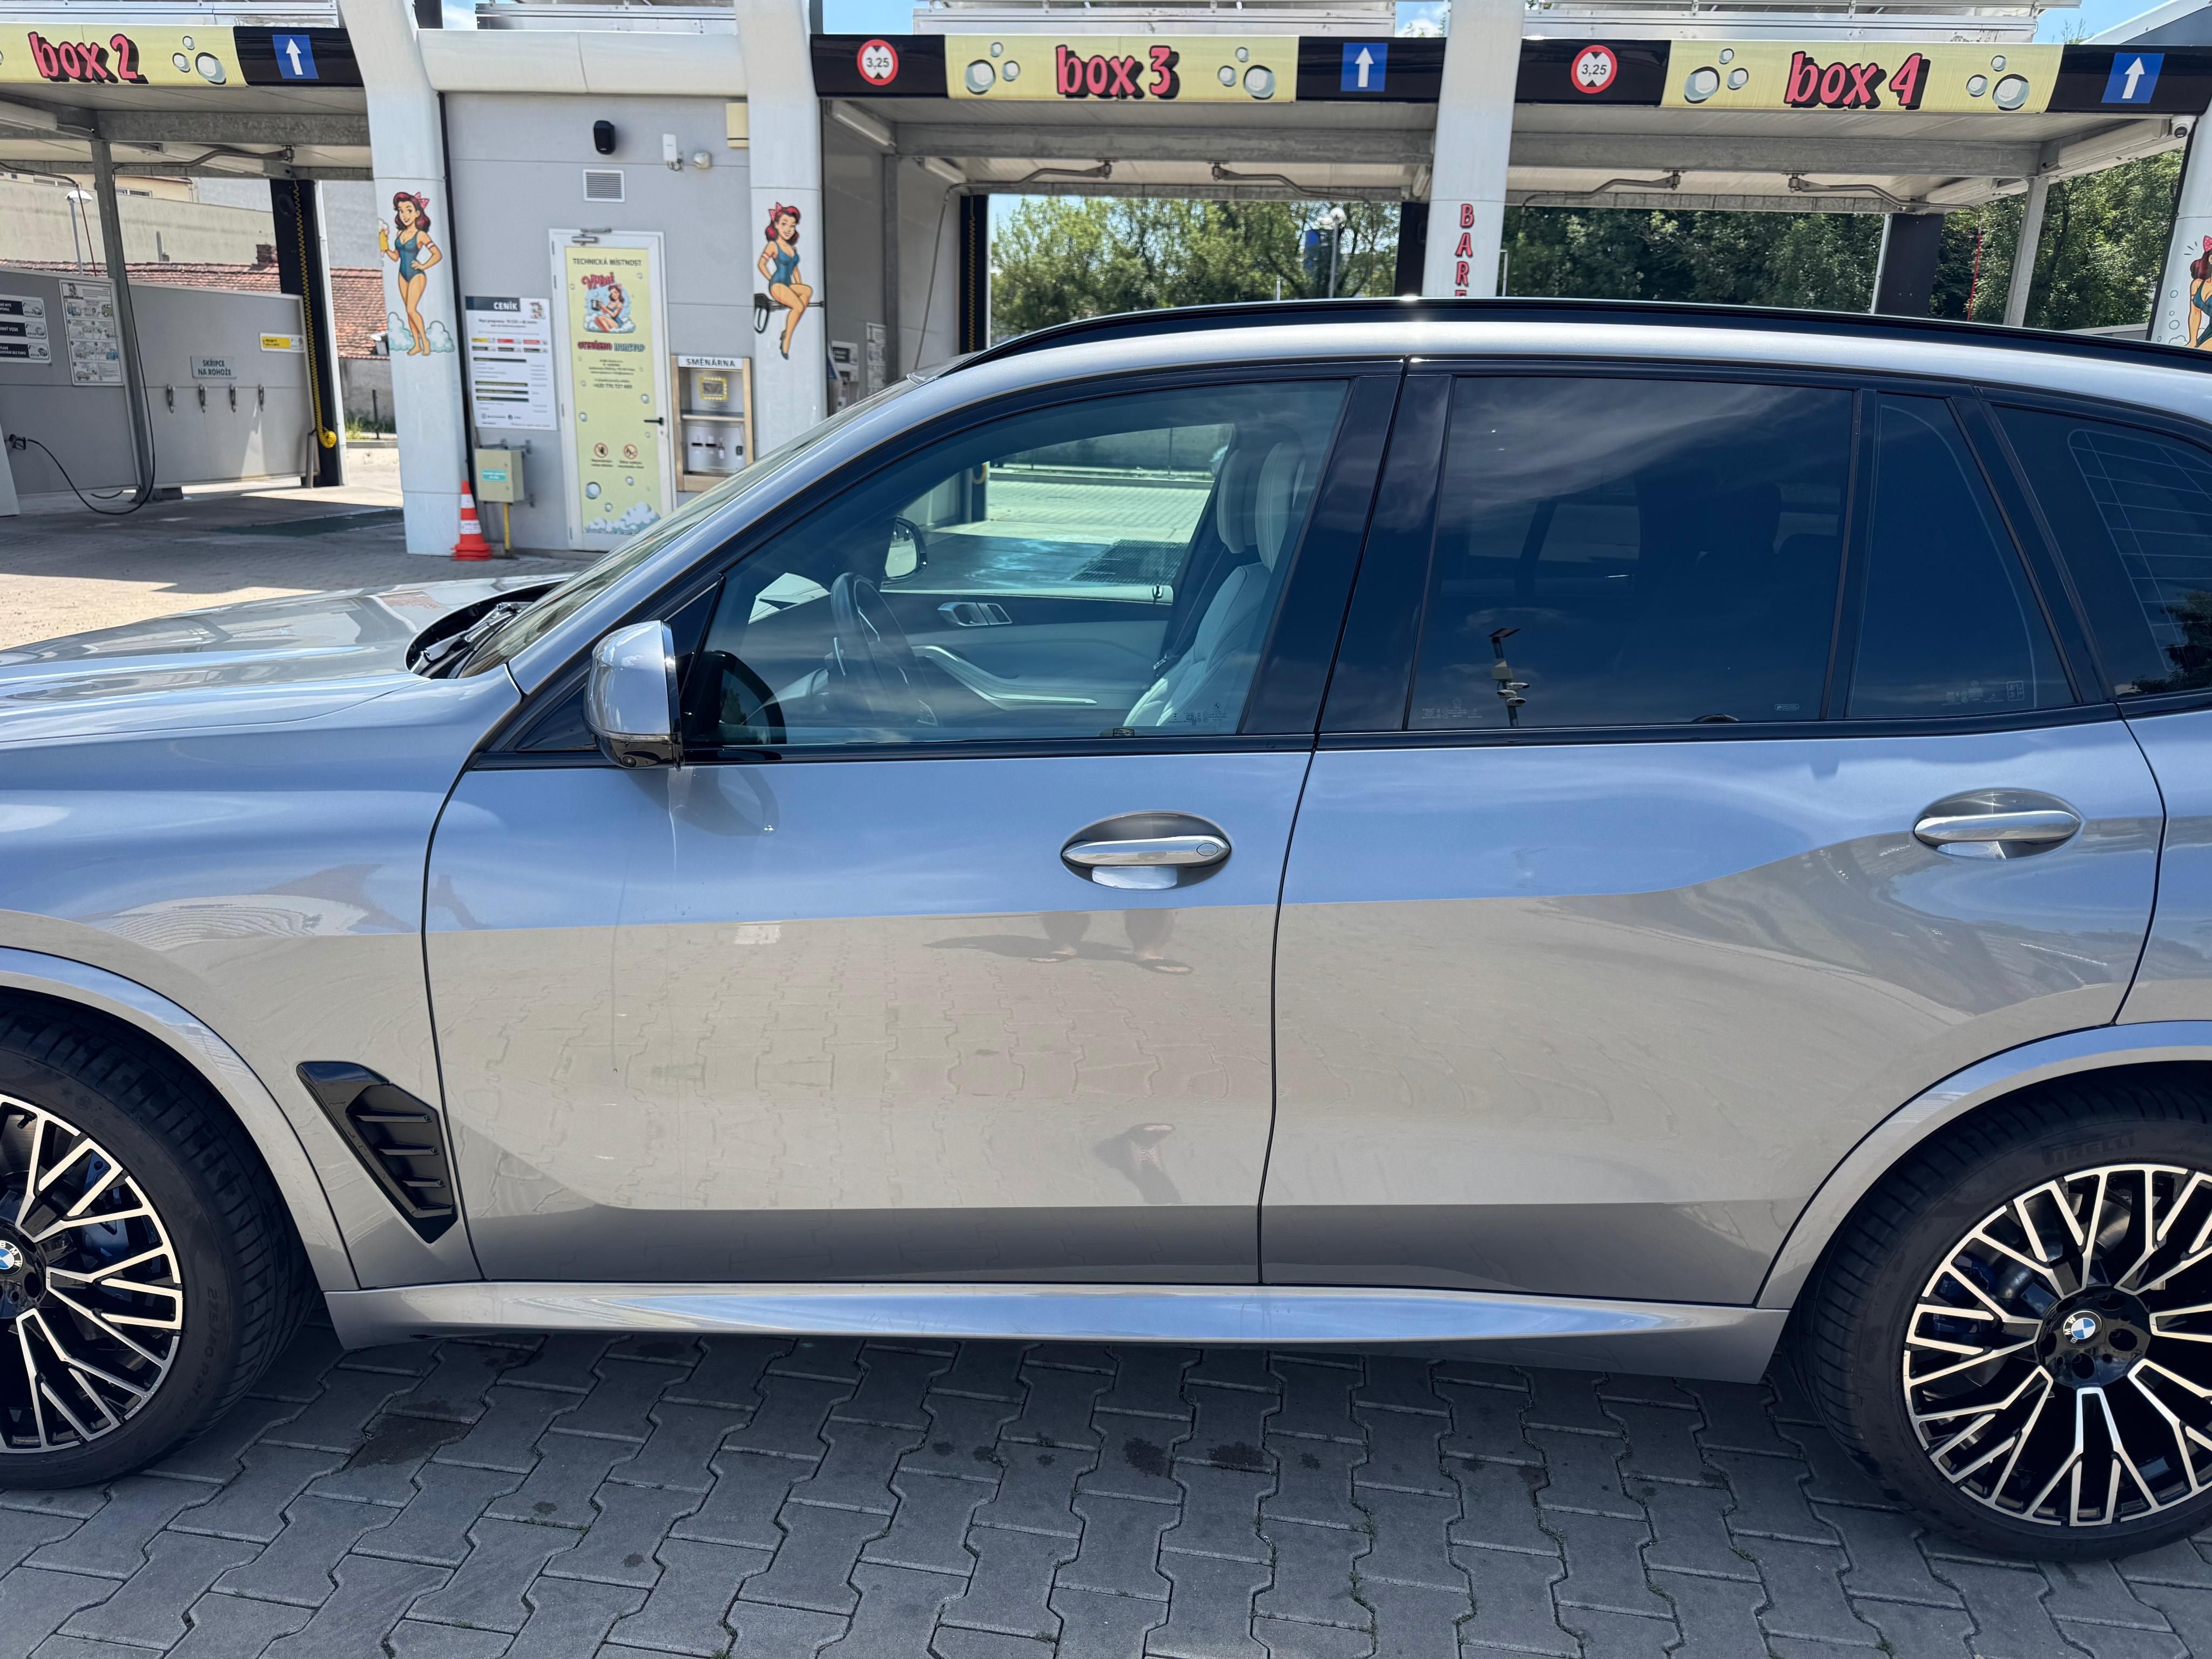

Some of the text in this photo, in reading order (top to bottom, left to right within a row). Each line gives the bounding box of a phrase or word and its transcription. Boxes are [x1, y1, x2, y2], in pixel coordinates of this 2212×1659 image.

[28, 31, 146, 83] box 2
[866, 57, 890, 70] 3,25
[1056, 44, 1178, 99] box 3
[1582, 64, 1607, 77] 3,25
[1783, 51, 1929, 109] box 4
[1455, 203, 1475, 297] BAR
[609, 258, 642, 266] MÍSTNOST
[493, 300, 518, 311] CENÍK
[203, 359, 225, 367] SKŘIPCE
[686, 358, 736, 367] SMĚNÁRNA
[208, 368, 232, 376] ROHOŽE
[0, 1242, 22, 1267] BMW
[2064, 1316, 2079, 1344] BMW
